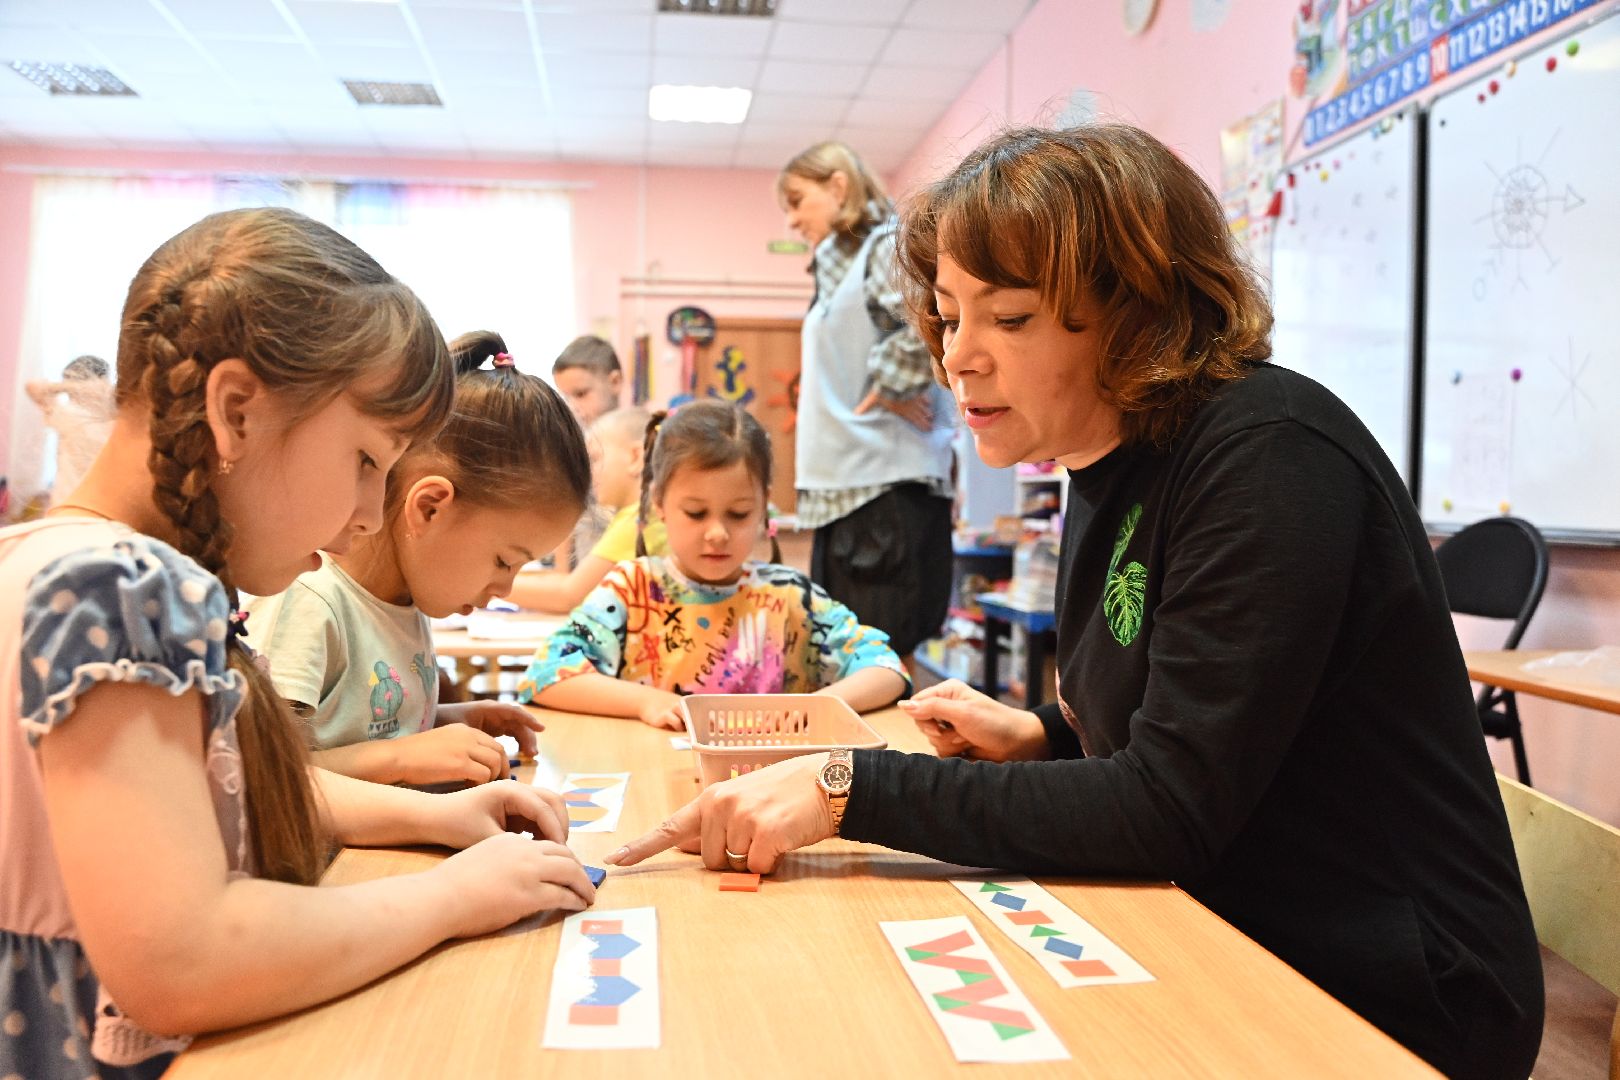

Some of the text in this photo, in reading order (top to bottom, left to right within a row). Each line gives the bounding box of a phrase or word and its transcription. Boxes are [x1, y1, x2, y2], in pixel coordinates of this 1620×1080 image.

[1374, 74, 1387, 106] 6
[1388, 67, 1400, 100] 7
[1402, 60, 1414, 92] 8
[1416, 52, 1428, 85] 9
[1450, 32, 1466, 68] 11
[1469, 22, 1486, 57] 12
[1488, 11, 1505, 47] 13
[1507, 0, 1528, 37] 14
